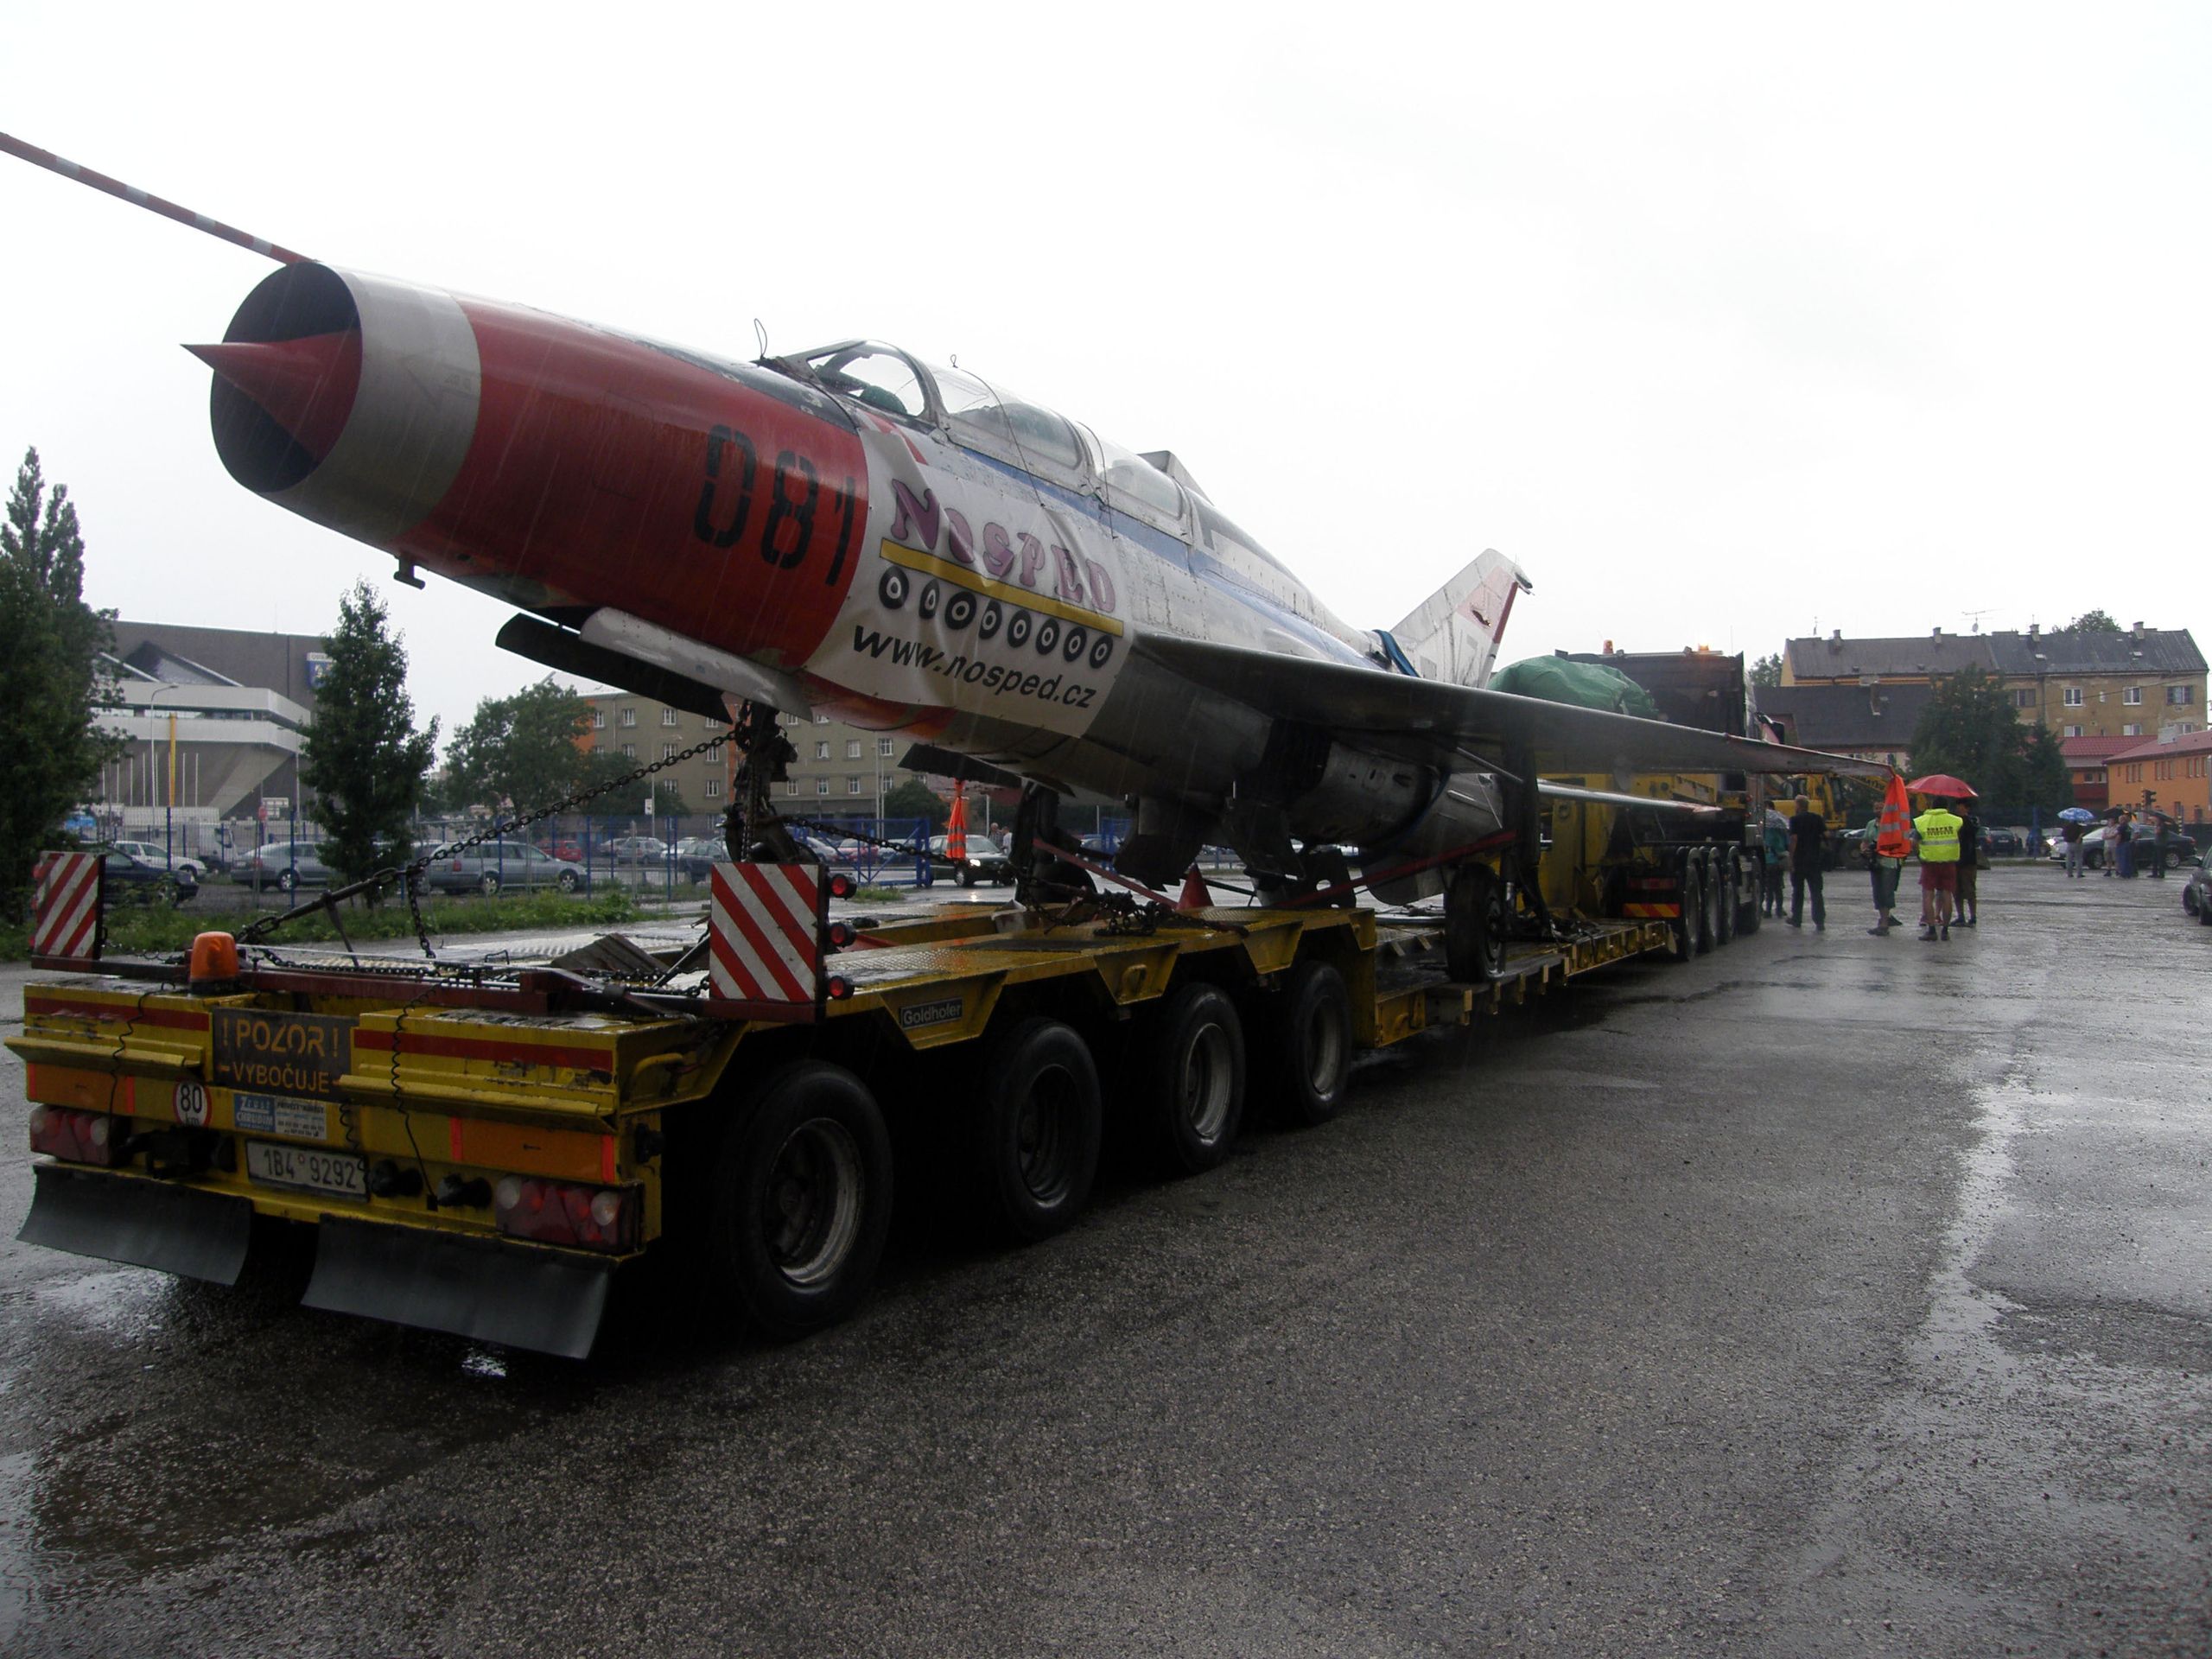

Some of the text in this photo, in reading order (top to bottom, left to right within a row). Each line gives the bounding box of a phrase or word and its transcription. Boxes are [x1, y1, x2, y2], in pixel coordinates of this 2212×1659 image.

[693, 423, 855, 587] 081
[891, 478, 1116, 613] NOSPED
[851, 624, 1097, 709] www.nosped.cz
[904, 1003, 961, 1025] Goldhofer
[236, 1018, 326, 1058] POZOR
[180, 1084, 202, 1114] 80
[264, 1147, 357, 1190] 1B4 9292
